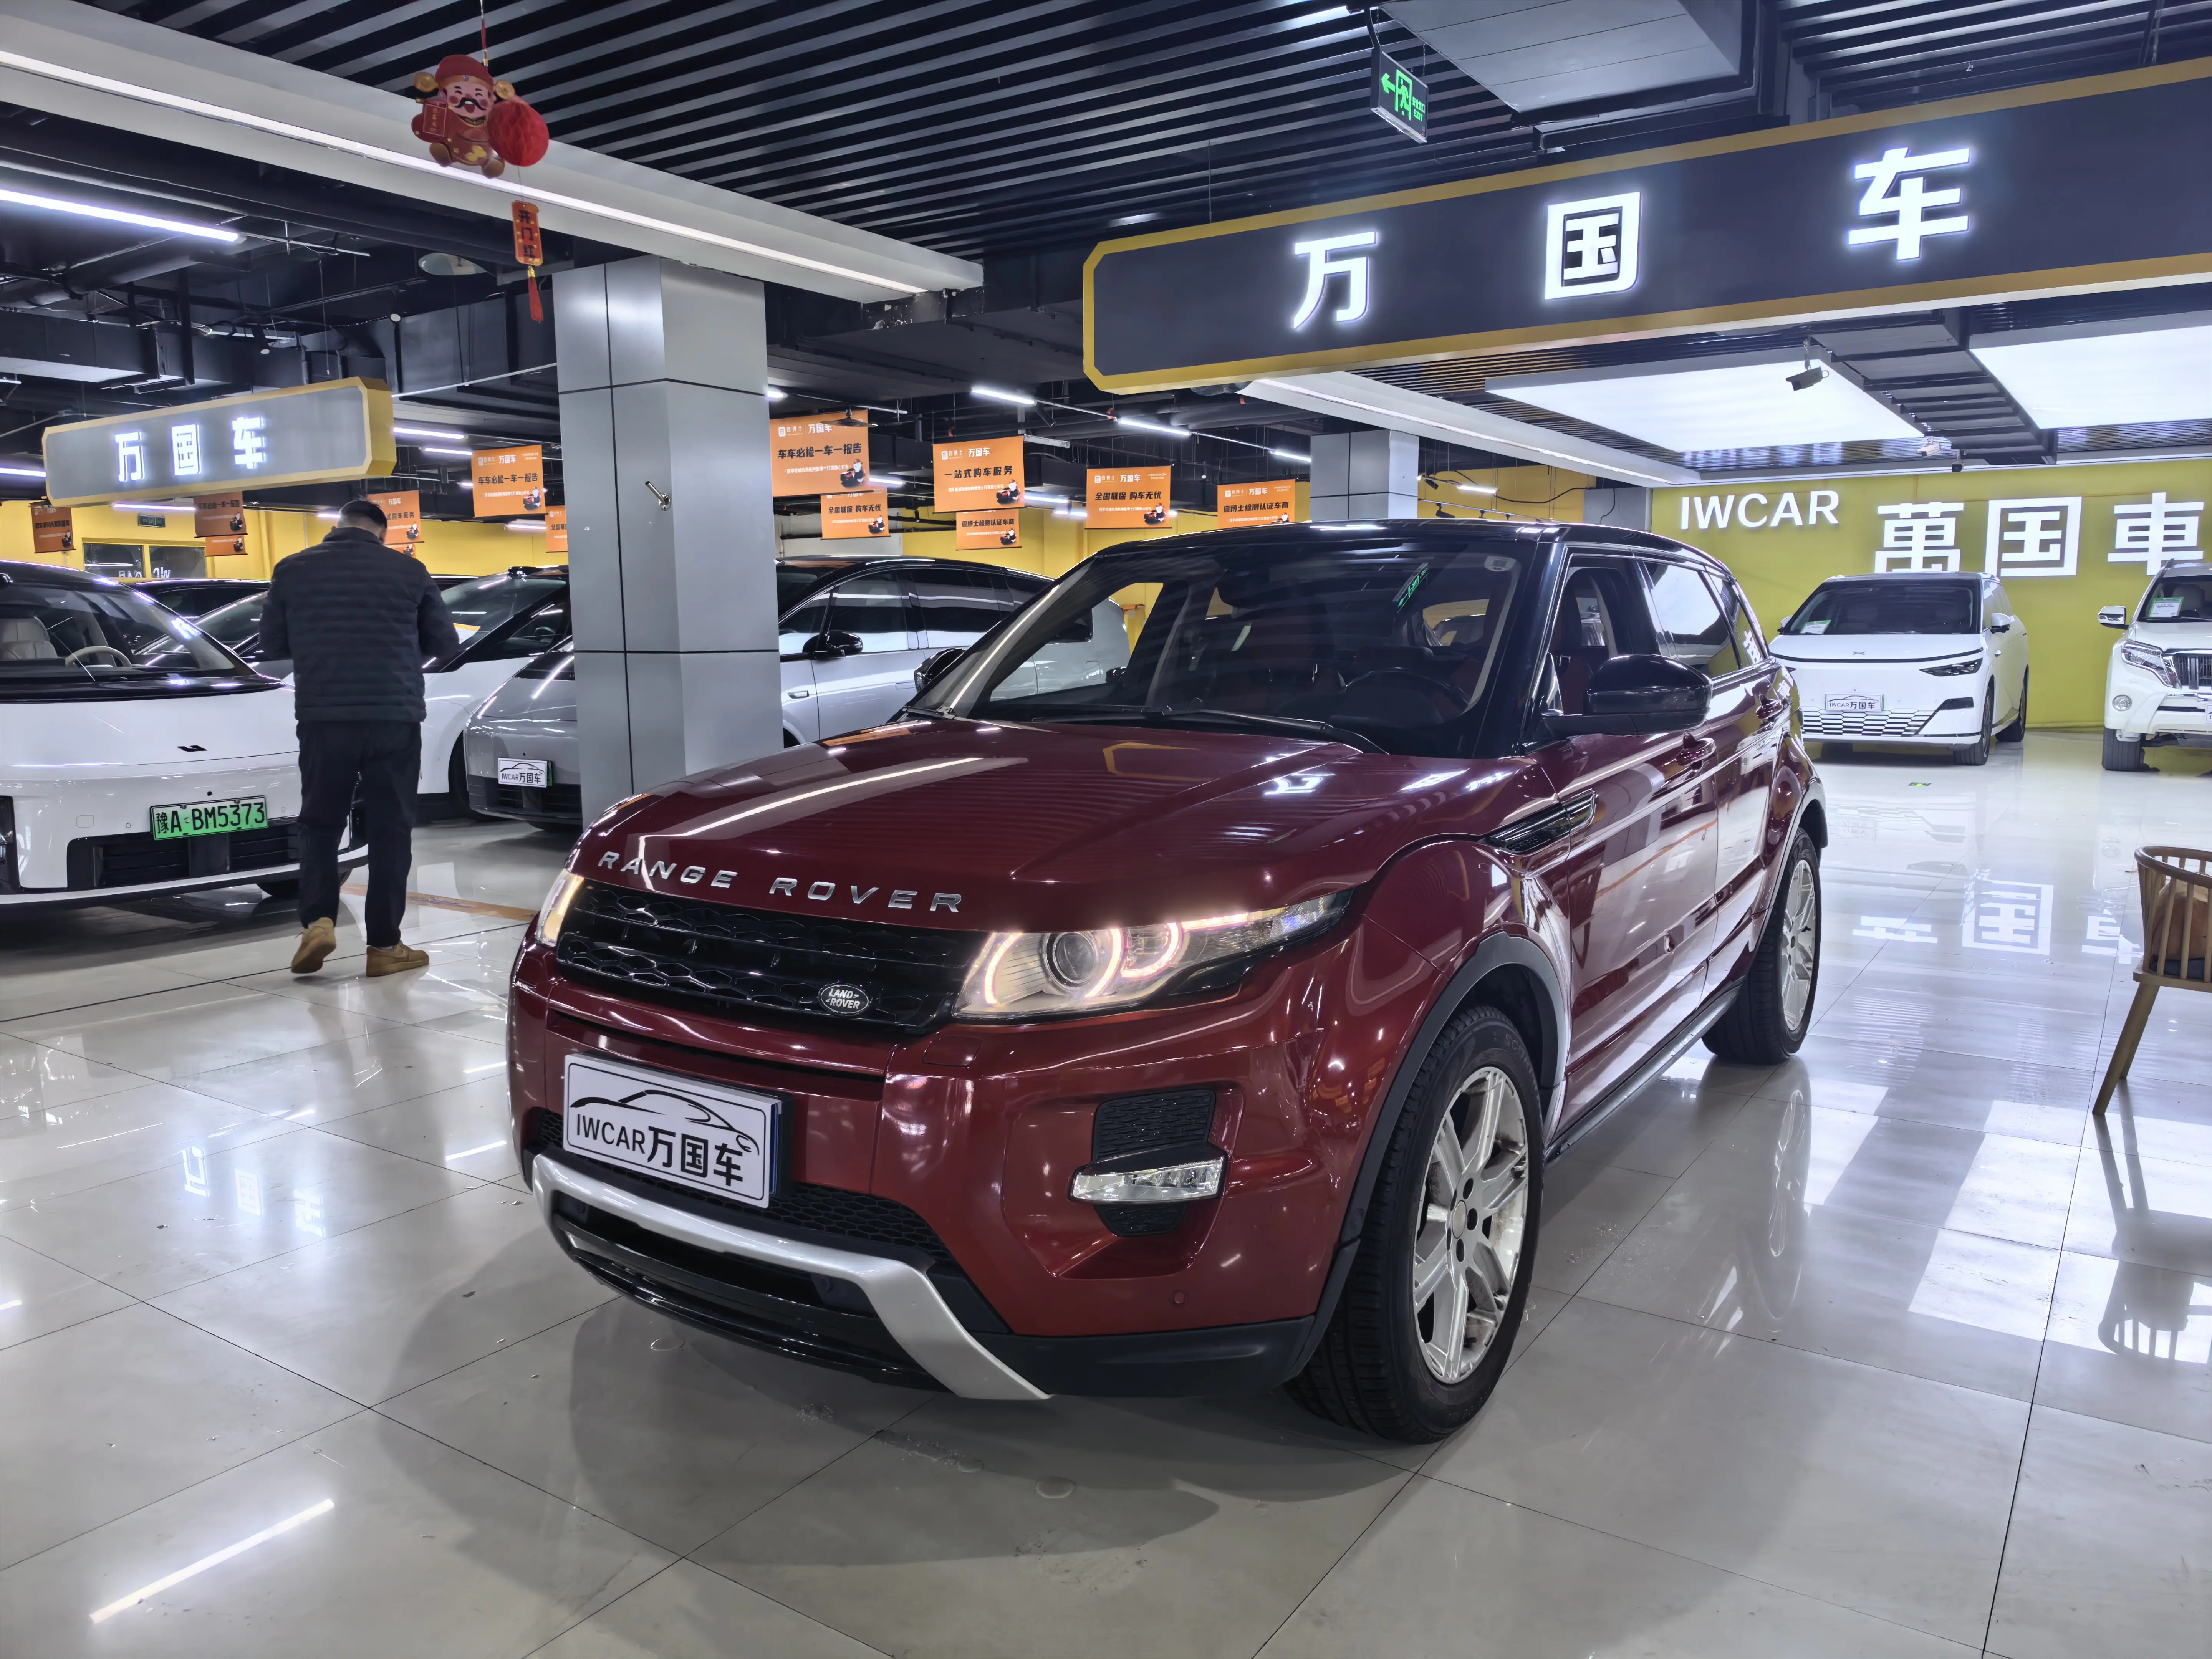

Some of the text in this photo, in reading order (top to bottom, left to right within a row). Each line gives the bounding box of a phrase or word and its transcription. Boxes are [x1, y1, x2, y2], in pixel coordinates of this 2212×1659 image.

[1414, 109, 1423, 121] EXIT
[1290, 147, 1972, 330] 万国车
[114, 416, 267, 482] 万国车
[778, 443, 862, 459] 车车必检一车一报告
[968, 447, 990, 457] 万国车
[944, 465, 1012, 479] 一站式购车服务
[1120, 474, 1141, 482] 万国车
[478, 473, 538, 485] 车车必检一车一报告
[1095, 491, 1162, 500] 全国联保 购车无忧
[1681, 490, 1839, 530] IWCAR
[502, 773, 541, 784] IWCAR万国车
[598, 851, 962, 912] RANGE ROVER
[830, 998, 860, 1009] ROVER
[577, 1114, 743, 1187] IWCAR万国车
